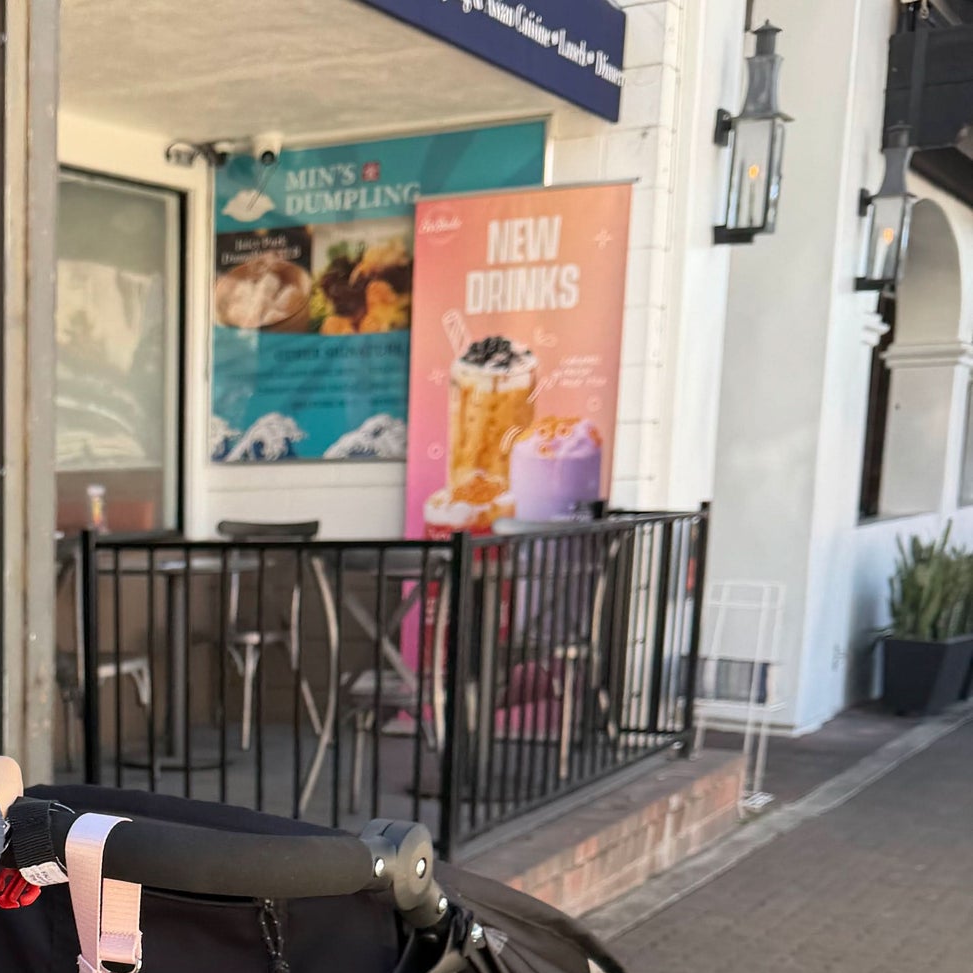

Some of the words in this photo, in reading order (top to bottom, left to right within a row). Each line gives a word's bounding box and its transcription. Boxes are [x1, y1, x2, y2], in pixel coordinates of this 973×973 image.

[515, 3, 552, 48] Cuisine
[285, 162, 357, 191] MIN'S
[285, 182, 421, 217] DUMPLING
[486, 214, 562, 265] NEW
[465, 263, 580, 316] DRINKS
